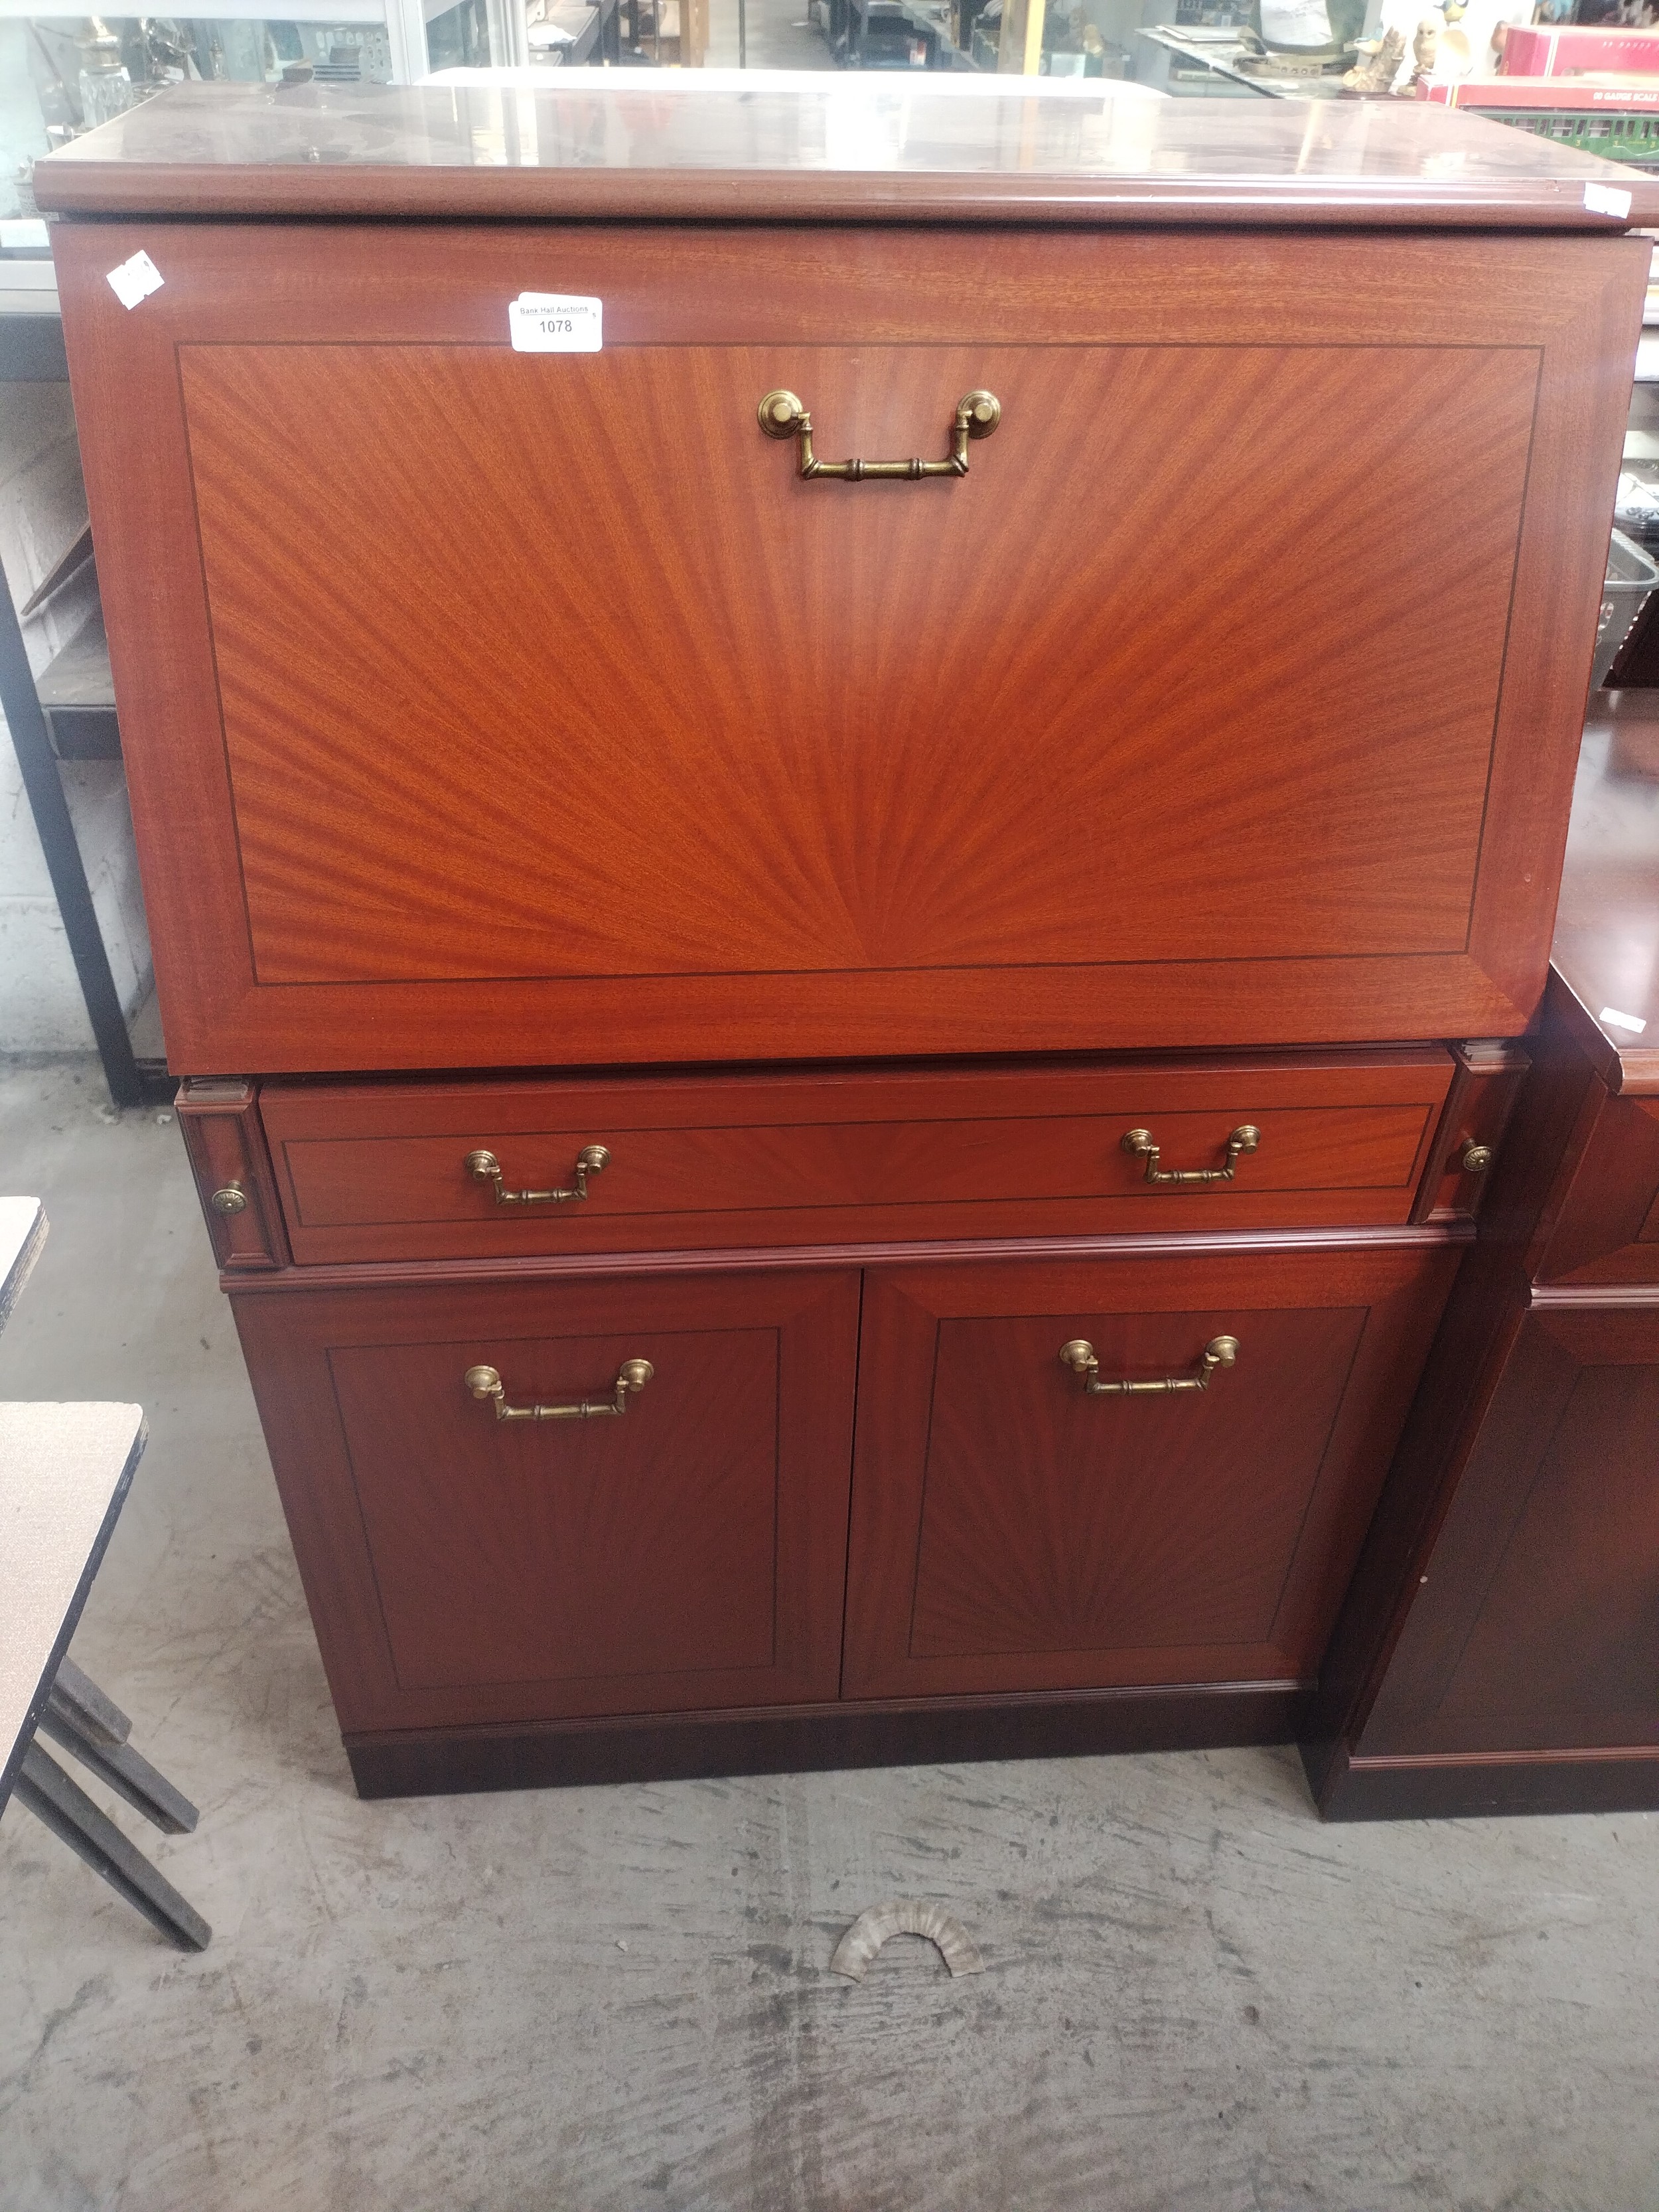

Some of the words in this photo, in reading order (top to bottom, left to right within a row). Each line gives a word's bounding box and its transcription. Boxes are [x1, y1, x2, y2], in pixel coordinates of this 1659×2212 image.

[1604, 92, 1632, 102] GAUGE
[1633, 93, 1658, 102] SCALE
[540, 319, 572, 333] 1078
